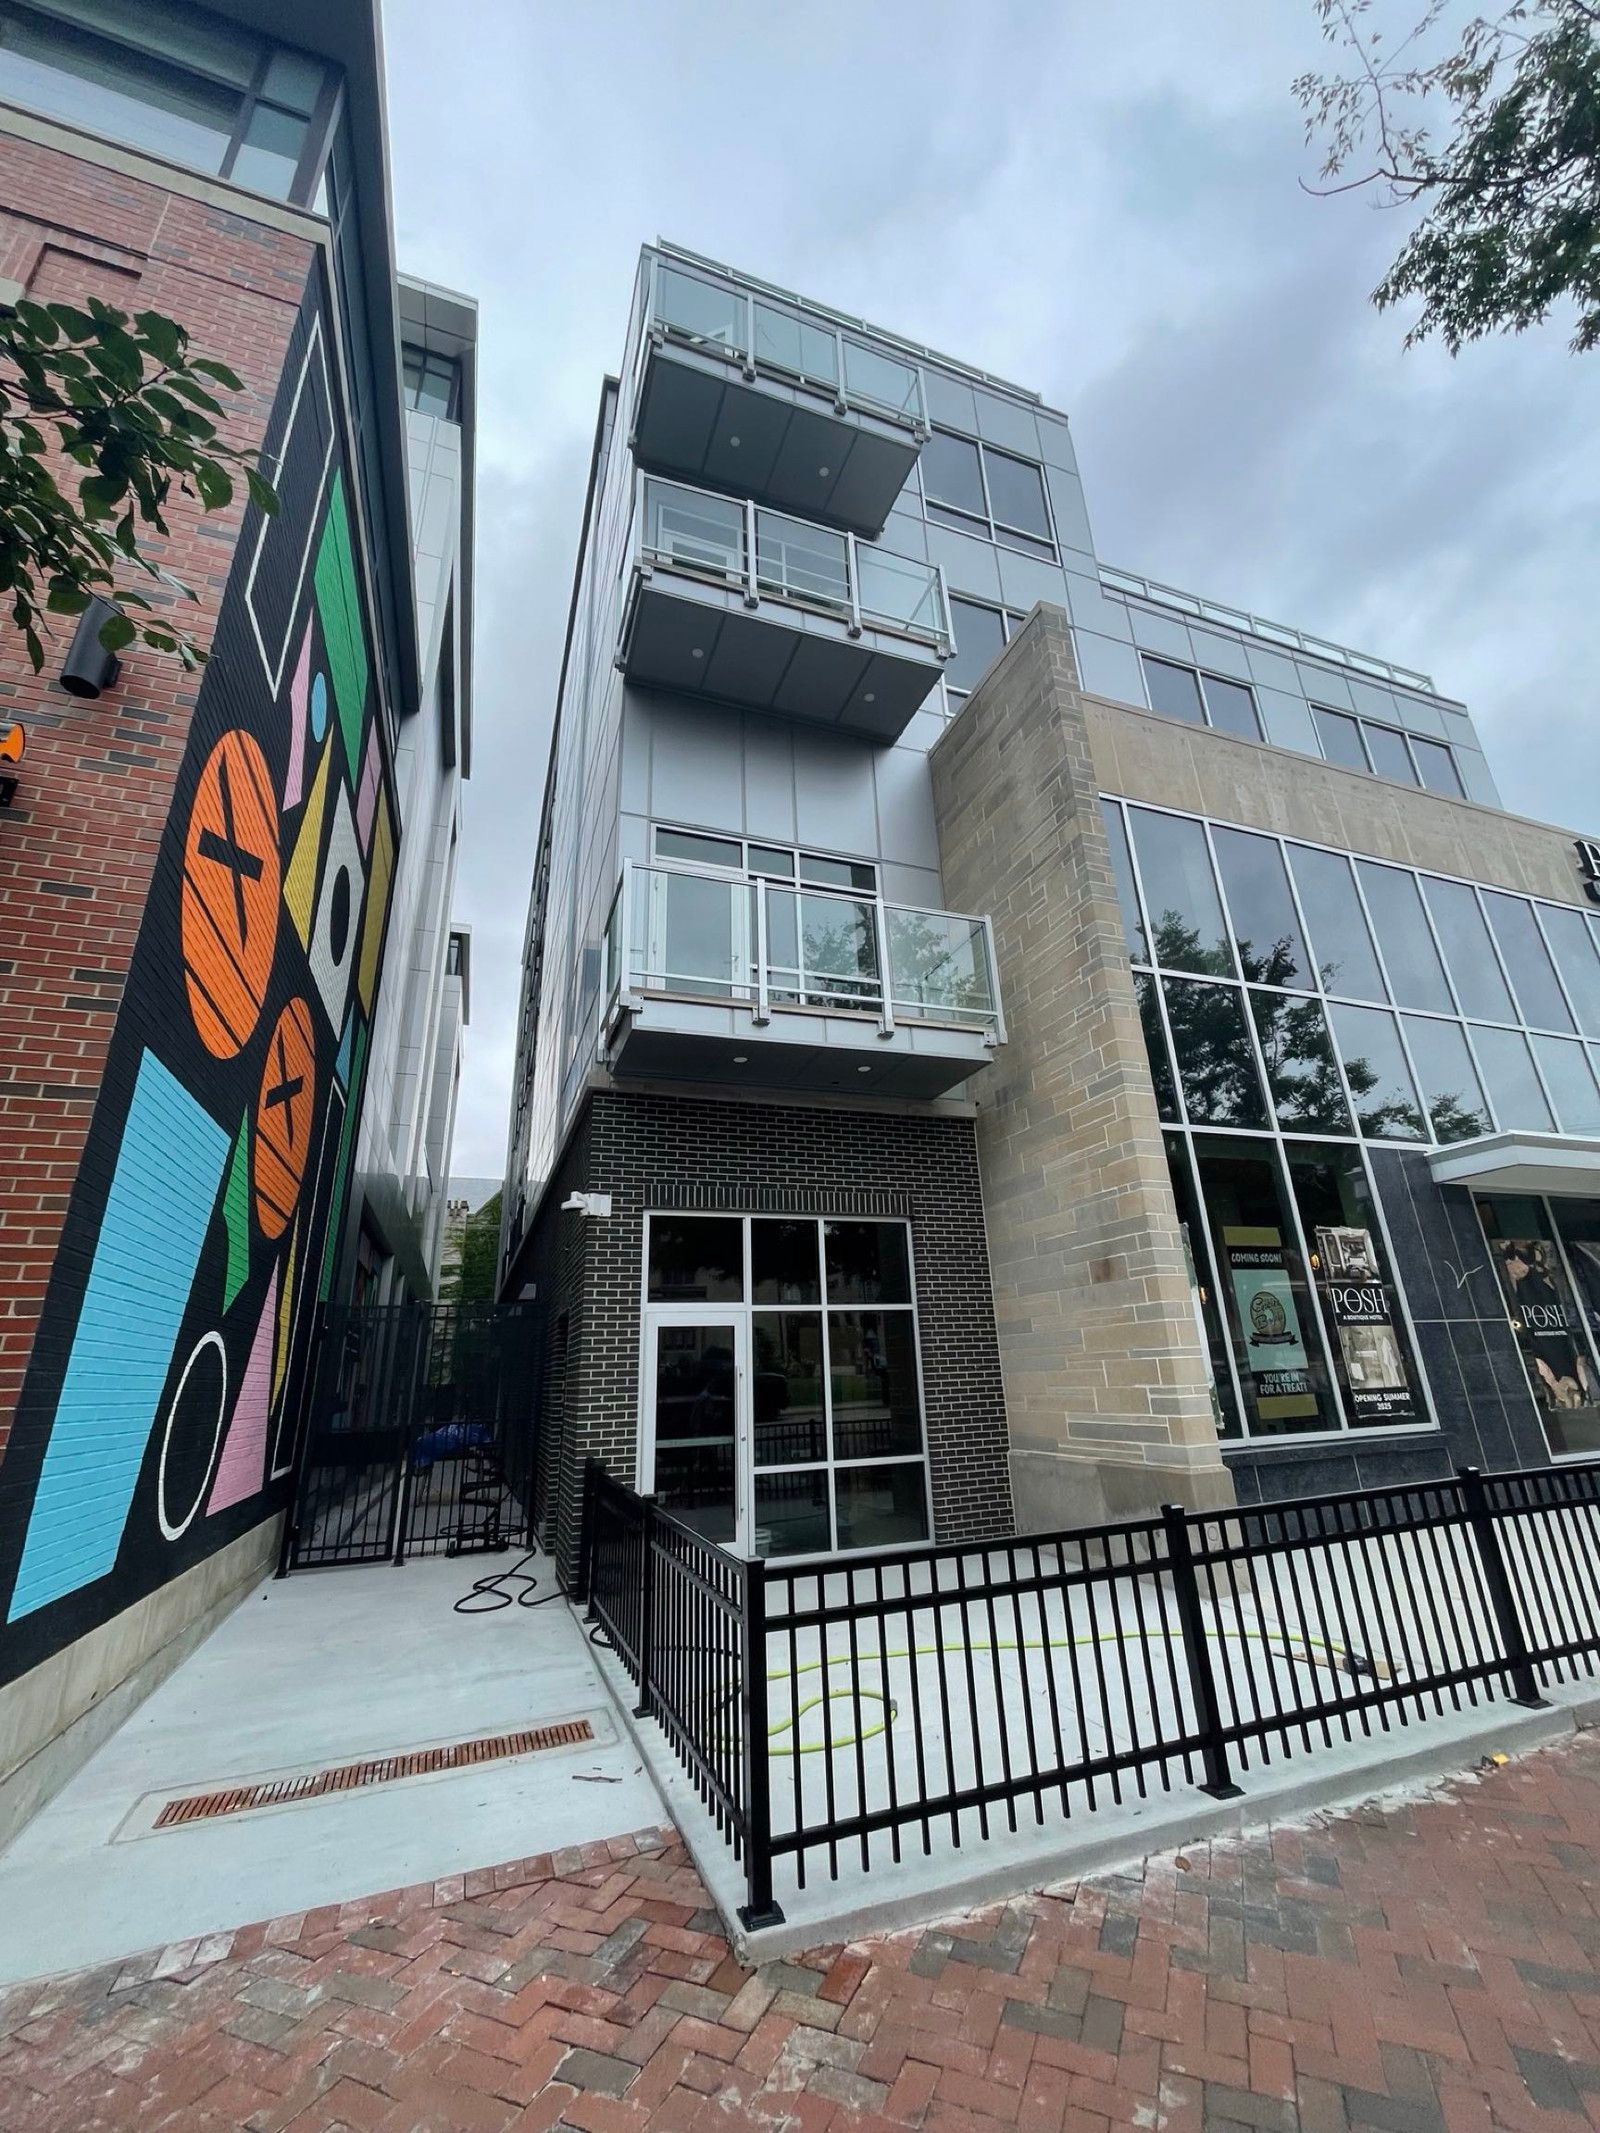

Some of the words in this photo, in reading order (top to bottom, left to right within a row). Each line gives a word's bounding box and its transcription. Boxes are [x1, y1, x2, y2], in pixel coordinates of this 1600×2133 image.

[1231, 1252, 1260, 1263] COMING
[1331, 1288, 1390, 1313] POSH
[1520, 1304, 1570, 1328] POSH
[1290, 1371, 1300, 1382] IN
[1260, 1384, 1276, 1394] FOR
[1275, 1383, 1283, 1393] A
[1354, 1393, 1383, 1402] OPENING
[1383, 1392, 1411, 1401] SUMMER
